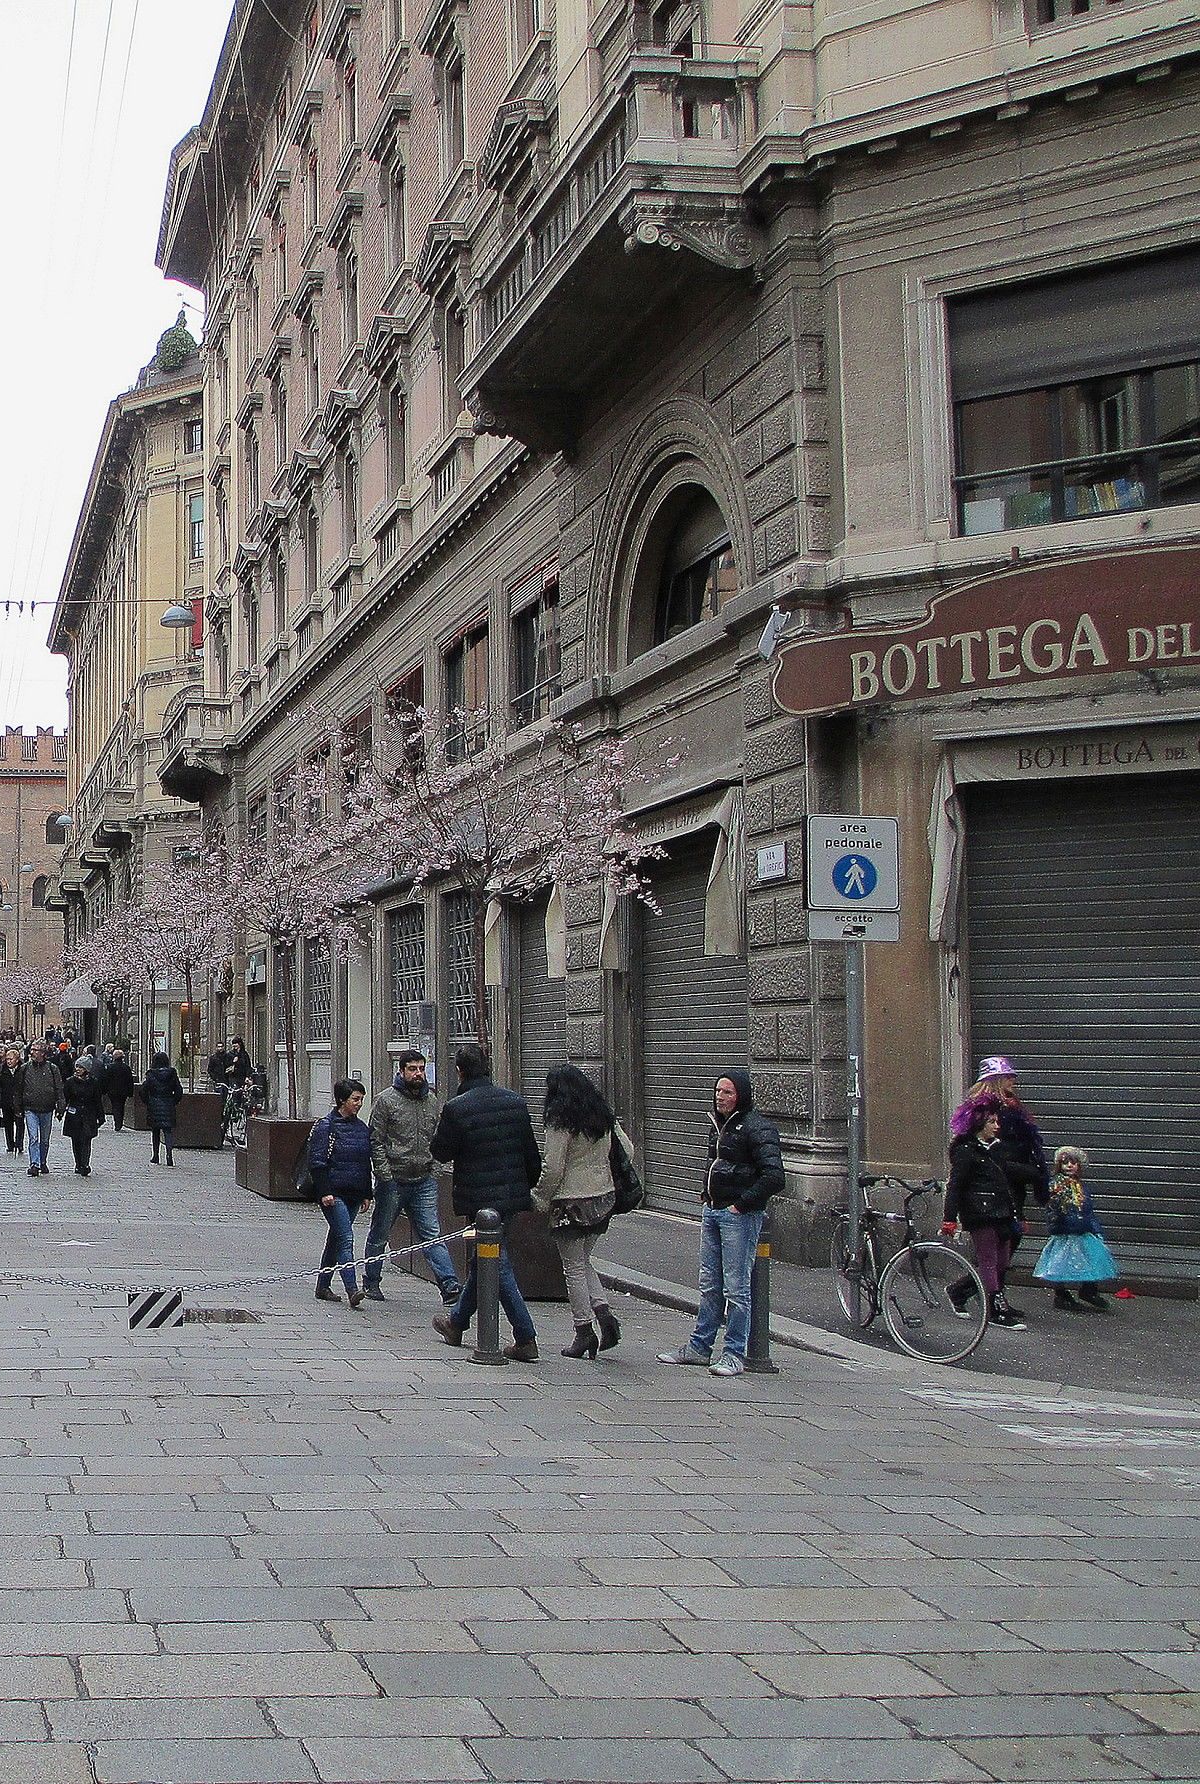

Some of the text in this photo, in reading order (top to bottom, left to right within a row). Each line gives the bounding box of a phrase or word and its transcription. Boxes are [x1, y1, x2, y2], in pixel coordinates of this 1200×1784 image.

[850, 613, 1109, 702] BOTTEGA
[1017, 739, 1155, 770] BOTTEGA
[839, 824, 867, 833] area
[825, 838, 882, 849] pedonale
[834, 914, 873, 922] eccetto
